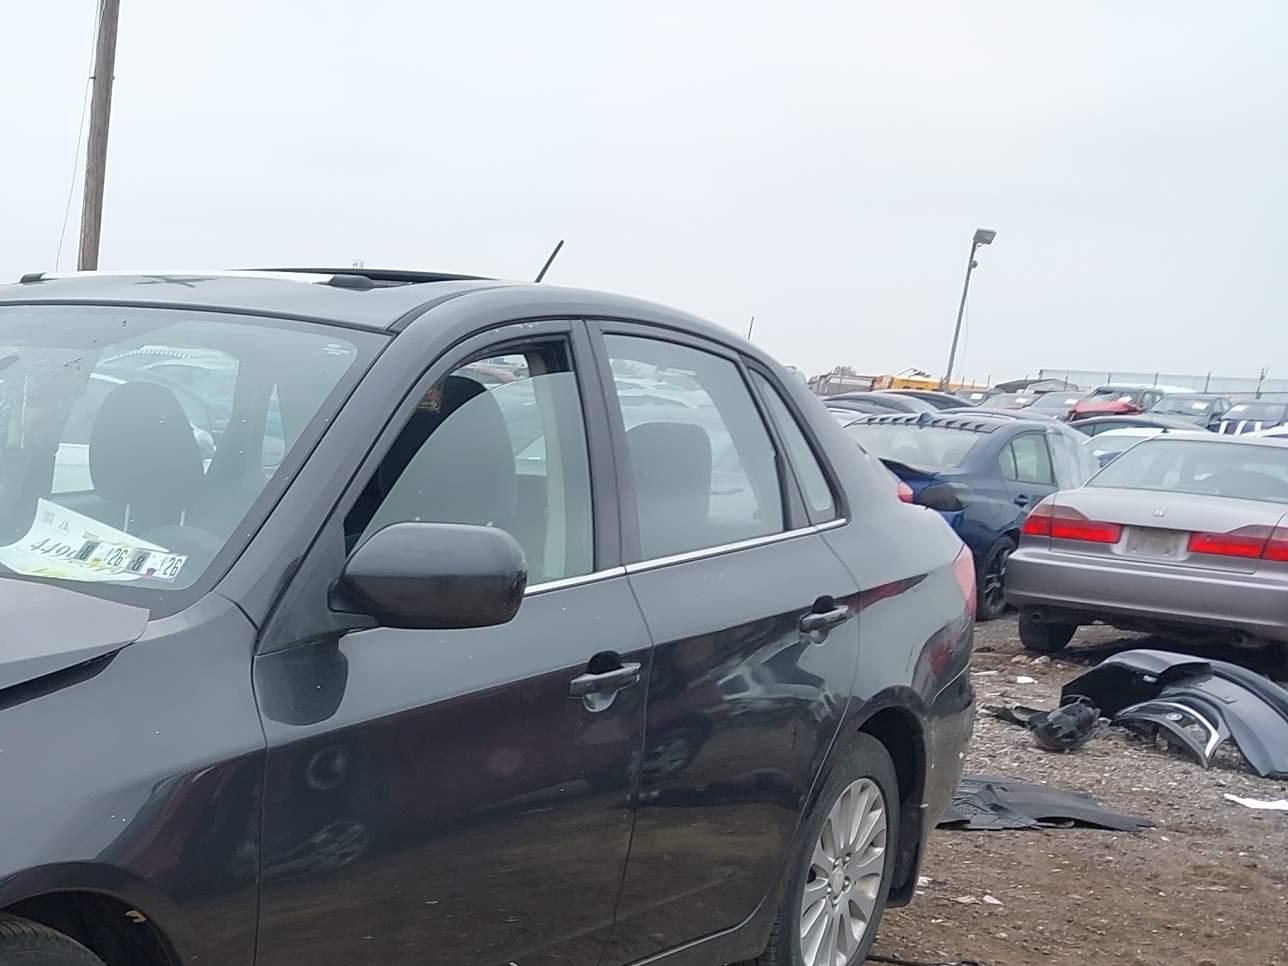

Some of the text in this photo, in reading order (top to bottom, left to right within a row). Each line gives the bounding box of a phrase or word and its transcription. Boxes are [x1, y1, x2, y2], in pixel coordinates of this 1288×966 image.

[80, 544, 128, 567] 8 26
[132, 555, 183, 576] 8 26
